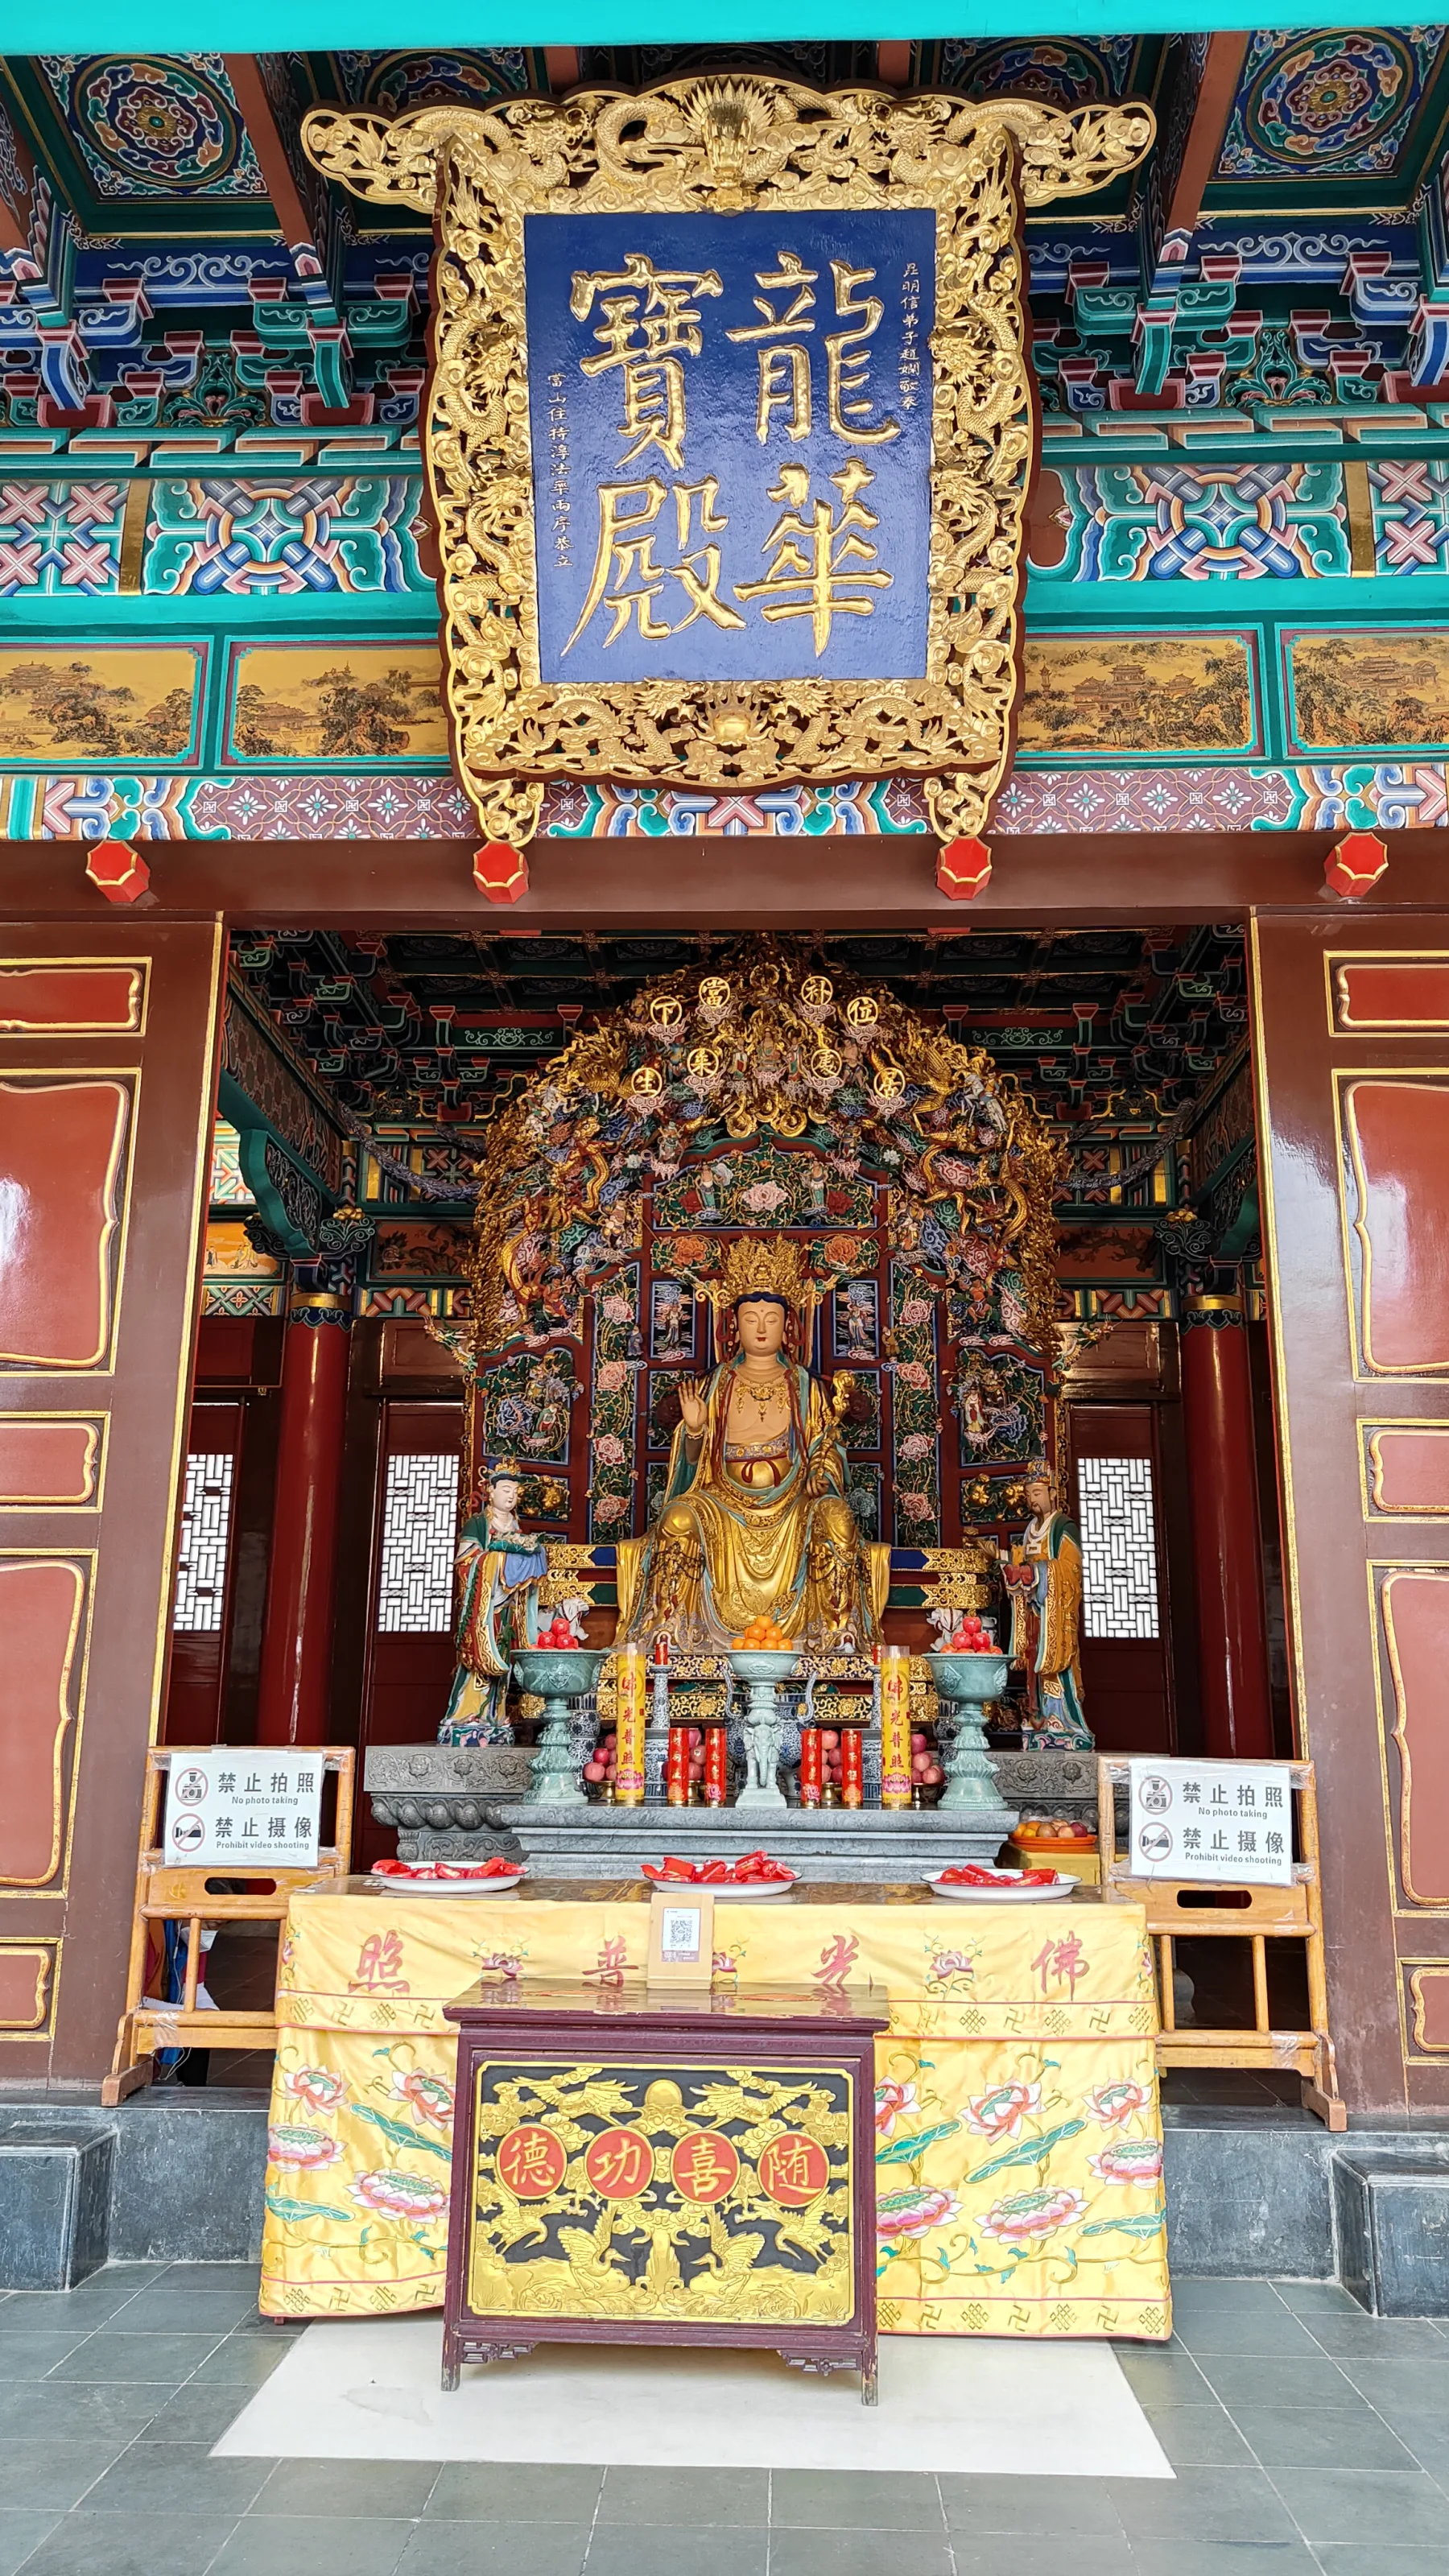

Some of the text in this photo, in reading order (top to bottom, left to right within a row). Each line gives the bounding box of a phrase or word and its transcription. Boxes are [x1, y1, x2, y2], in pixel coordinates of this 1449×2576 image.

[561, 253, 746, 656] 寶殿
[729, 250, 902, 658] 龍華
[654, 1002, 678, 1027] 下
[849, 998, 876, 1026] 位
[635, 1069, 658, 1094] 生
[621, 1671, 637, 1765] 佛光普照
[888, 1674, 904, 1769] 佛光普照
[218, 1772, 314, 1794] 禁止拍照
[1183, 1781, 1283, 1808] 禁止拍照
[232, 1796, 298, 1806] No photo taking
[1199, 1806, 1267, 1819] No photo taking
[215, 1817, 312, 1838] 禁止摄像
[1183, 1827, 1284, 1854] 禁止摄像
[217, 1841, 309, 1850] Prohibit video shooting
[1185, 1852, 1282, 1866] Prohibit video shooting
[348, 1930, 410, 1993] 照
[1031, 1930, 1090, 2001] 佛
